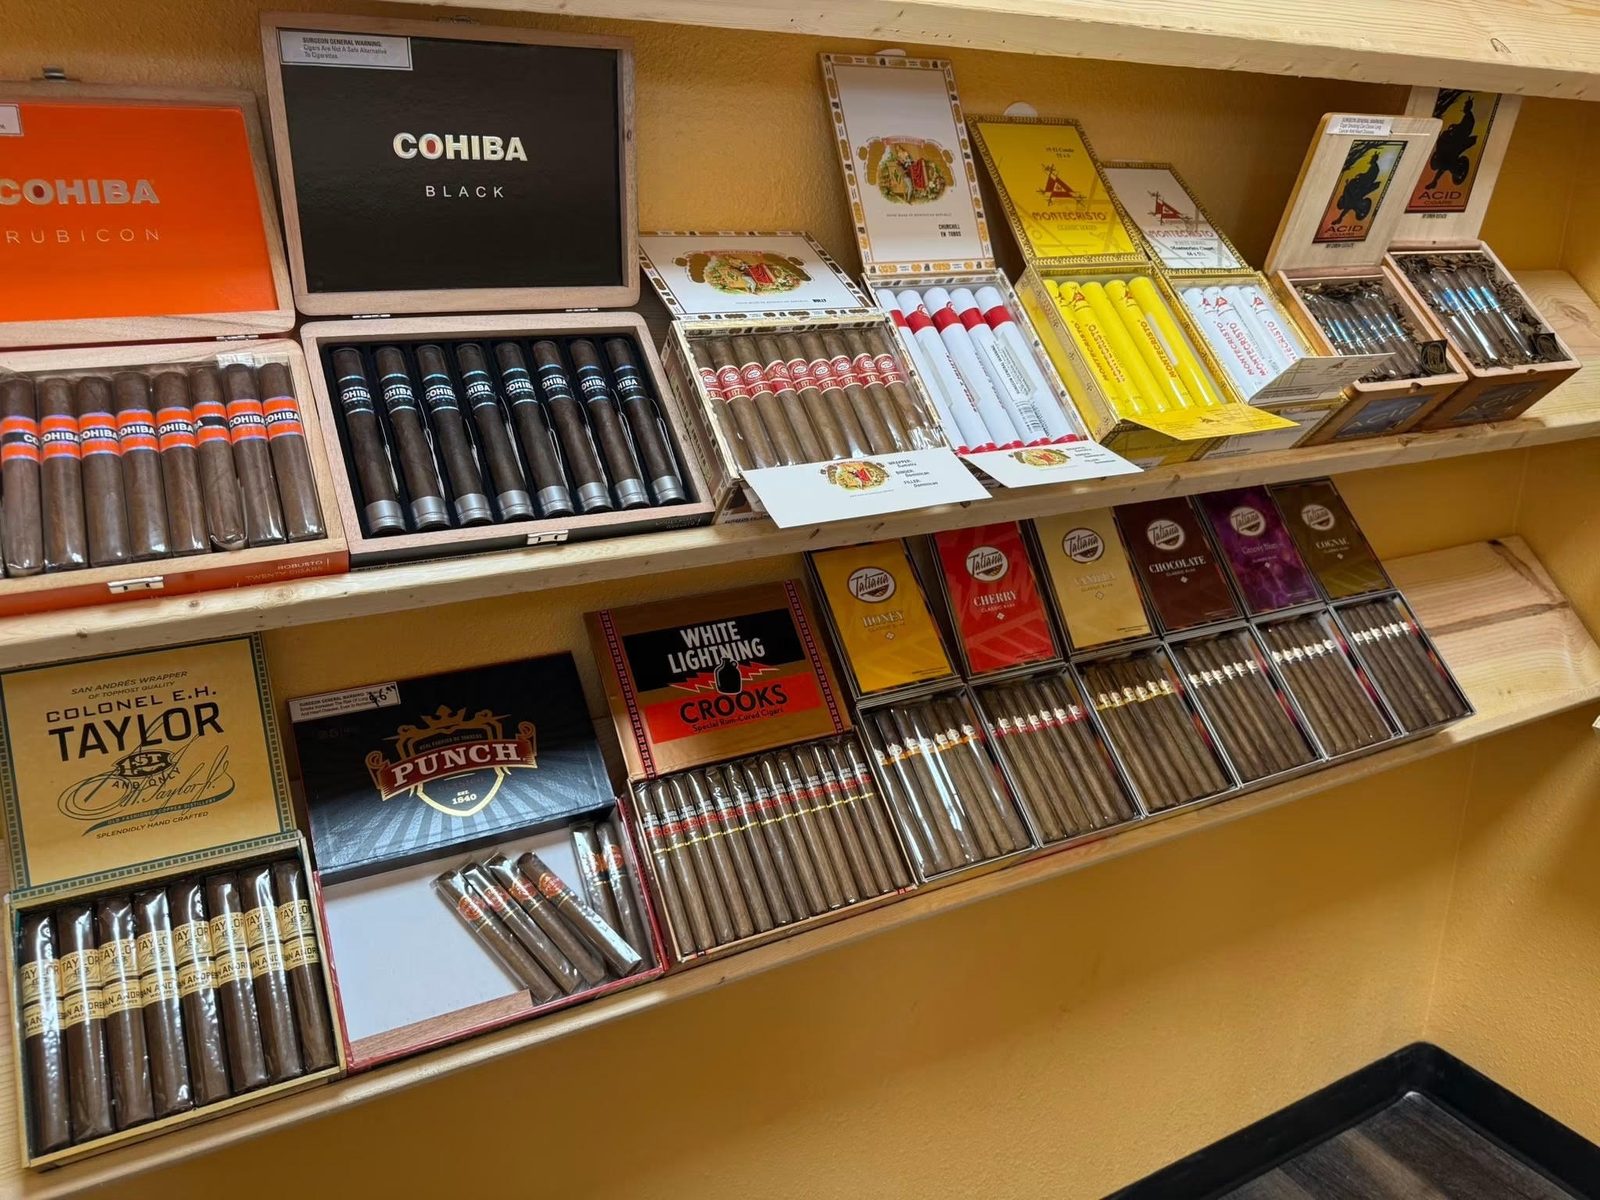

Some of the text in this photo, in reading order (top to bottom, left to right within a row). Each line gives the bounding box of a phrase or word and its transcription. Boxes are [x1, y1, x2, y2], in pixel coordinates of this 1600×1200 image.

[393, 132, 528, 161] COHIBA
[0, 178, 160, 205] COHIBA
[425, 185, 504, 198] BLACK
[1418, 191, 1462, 200] ACID
[1032, 211, 1106, 221] MONTECRISTO
[6, 228, 160, 244] RUBICON
[1149, 230, 1213, 238] MONTECRISTO
[1325, 225, 1364, 233] ACID
[1074, 322, 1109, 381] MONTECRISTO
[1088, 323, 1126, 384] MONTECRISTO
[1140, 320, 1177, 379] MONTECRISTO
[1216, 321, 1255, 376] MONTECRISTO
[1229, 322, 1268, 377] MONTECRISTO
[1231, 510, 1260, 532] Tatiana
[1302, 507, 1329, 526] Tatiana
[1064, 534, 1100, 557] Tatiana
[1148, 523, 1180, 545] Tatiana
[968, 551, 1004, 577] Tatiana
[1149, 555, 1206, 574] CHOCOLATE
[850, 572, 889, 598] Tatiana
[973, 590, 1017, 607] CHERRY
[862, 610, 905, 628] HONEY
[680, 620, 740, 649] WHITE
[667, 637, 766, 674] LIGHTNING
[71, 684, 93, 695] SAN
[138, 671, 188, 686] WRAPPER
[88, 680, 176, 700] OF TOPMOST QUALITY
[46, 685, 217, 723] COLONEL E.H.
[680, 684, 788, 724] CROOKS
[48, 701, 225, 762] TAYLOR
[692, 719, 720, 732] Special
[120, 753, 163, 777] 1ST
[391, 743, 521, 787] PUNCH
[111, 767, 182, 790] AND ONLY
[452, 793, 478, 805] 1840
[146, 819, 171, 829] HAND
[172, 811, 209, 823] CRAFTED
